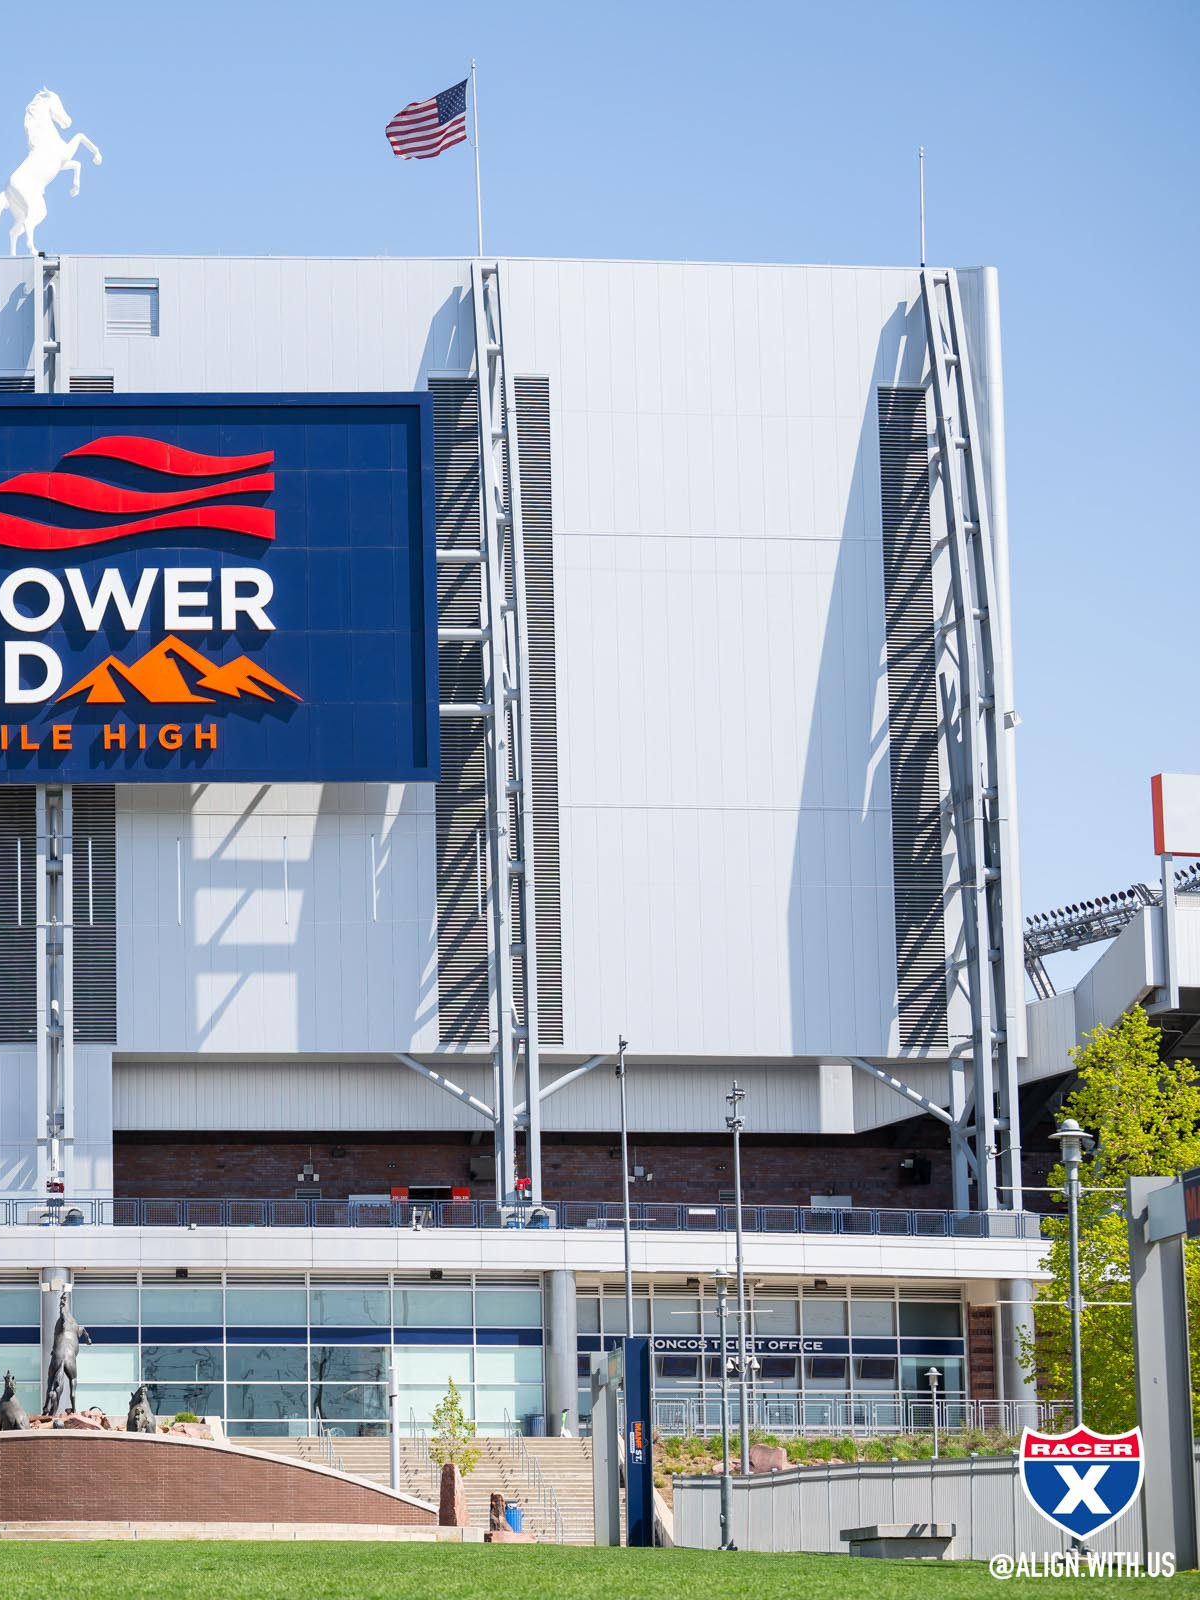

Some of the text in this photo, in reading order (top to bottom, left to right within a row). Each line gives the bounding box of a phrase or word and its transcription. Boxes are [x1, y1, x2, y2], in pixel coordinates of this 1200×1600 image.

[103, 723, 218, 750] HIGH
[649, 1339, 823, 1351] ONCOS TCET OFFICE
[634, 1423, 643, 1462] MANE ST.
